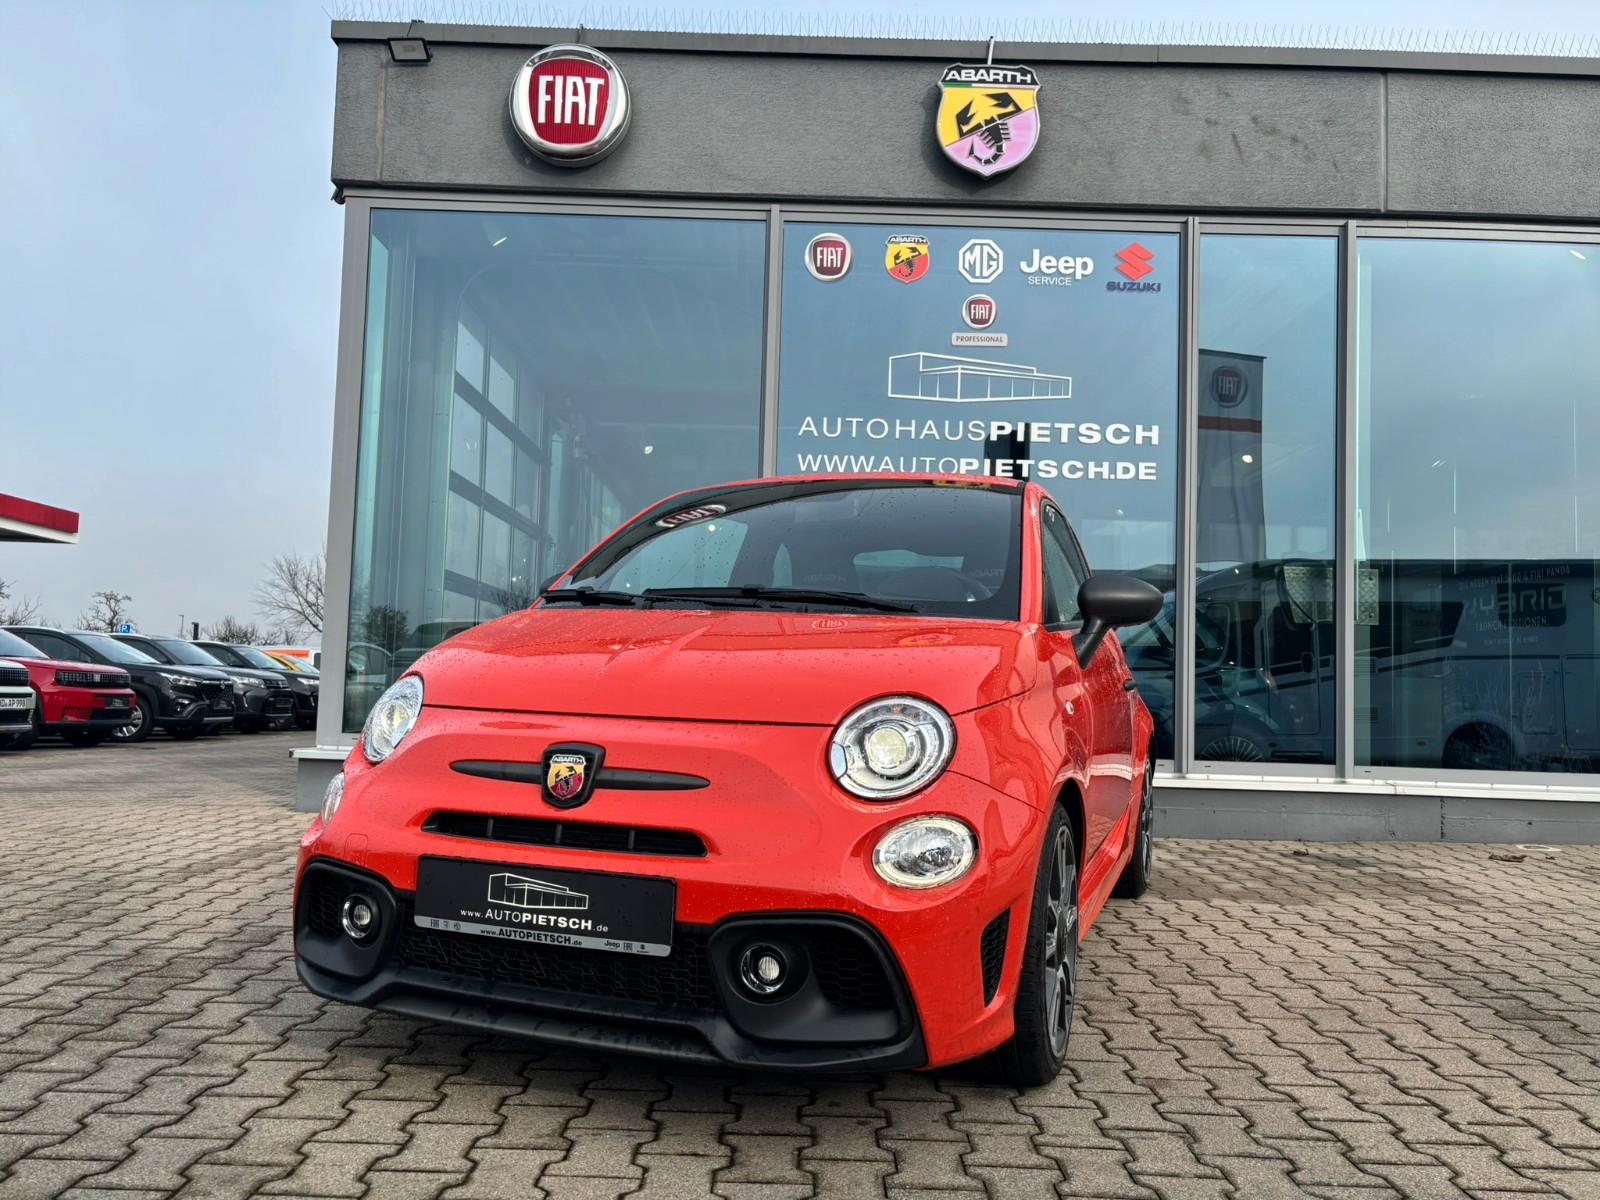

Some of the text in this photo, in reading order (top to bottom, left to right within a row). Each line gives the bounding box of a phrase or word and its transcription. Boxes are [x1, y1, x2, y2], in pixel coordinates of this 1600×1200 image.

[945, 69, 1032, 84] ABARTH
[538, 75, 605, 125] FIAT
[889, 235, 927, 244] ABARTH
[816, 246, 844, 268] FIAT
[964, 244, 998, 277] MG
[1020, 248, 1094, 280] Jeep
[1027, 276, 1072, 287] SERVICE
[1106, 281, 1161, 292] SUZUKI
[970, 304, 990, 320] FIAT
[956, 334, 1004, 344] PROFESSIONAL
[798, 415, 1160, 446] AUTOHAUSPIETSCH
[797, 453, 1158, 481] WWW.AUTOPIETSCH.DE
